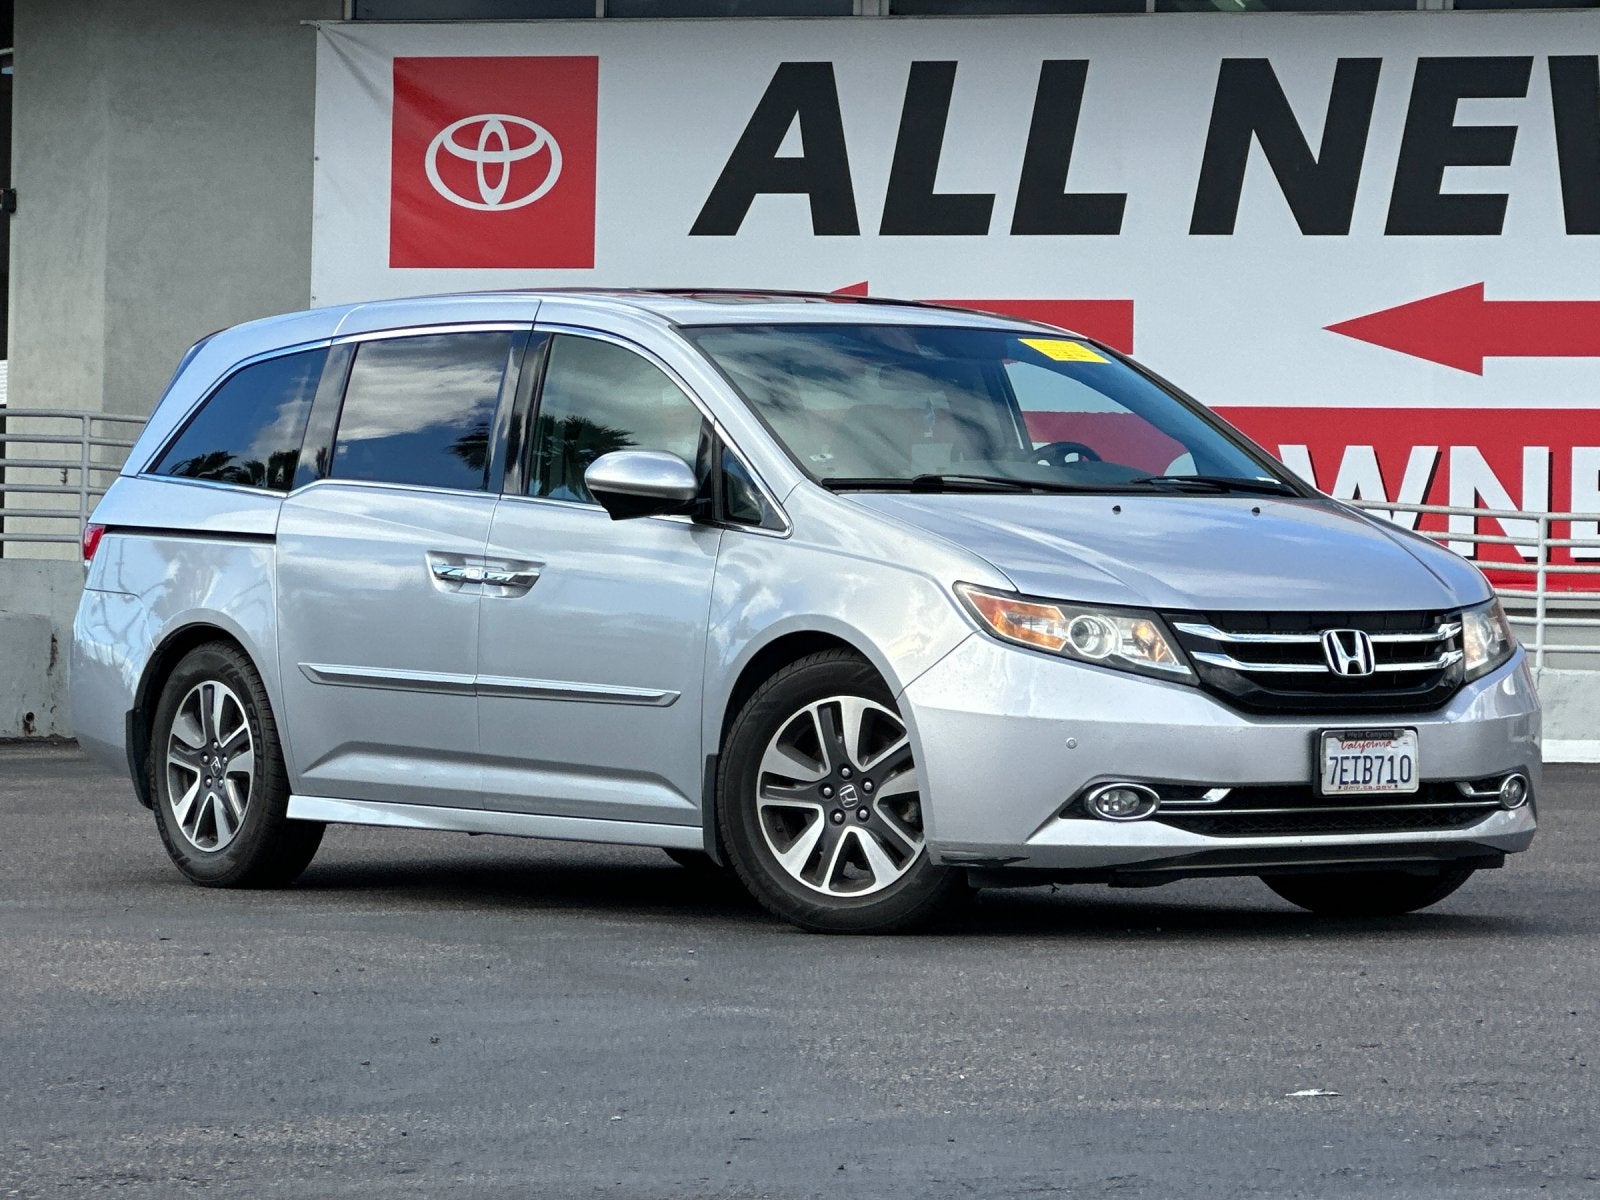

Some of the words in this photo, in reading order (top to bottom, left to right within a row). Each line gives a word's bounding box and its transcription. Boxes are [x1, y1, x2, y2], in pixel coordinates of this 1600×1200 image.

[688, 59, 1128, 236] ALL
[1189, 55, 1600, 236] NE
[1341, 740, 1394, 754] California
[1329, 754, 1412, 785] 7EIB710
